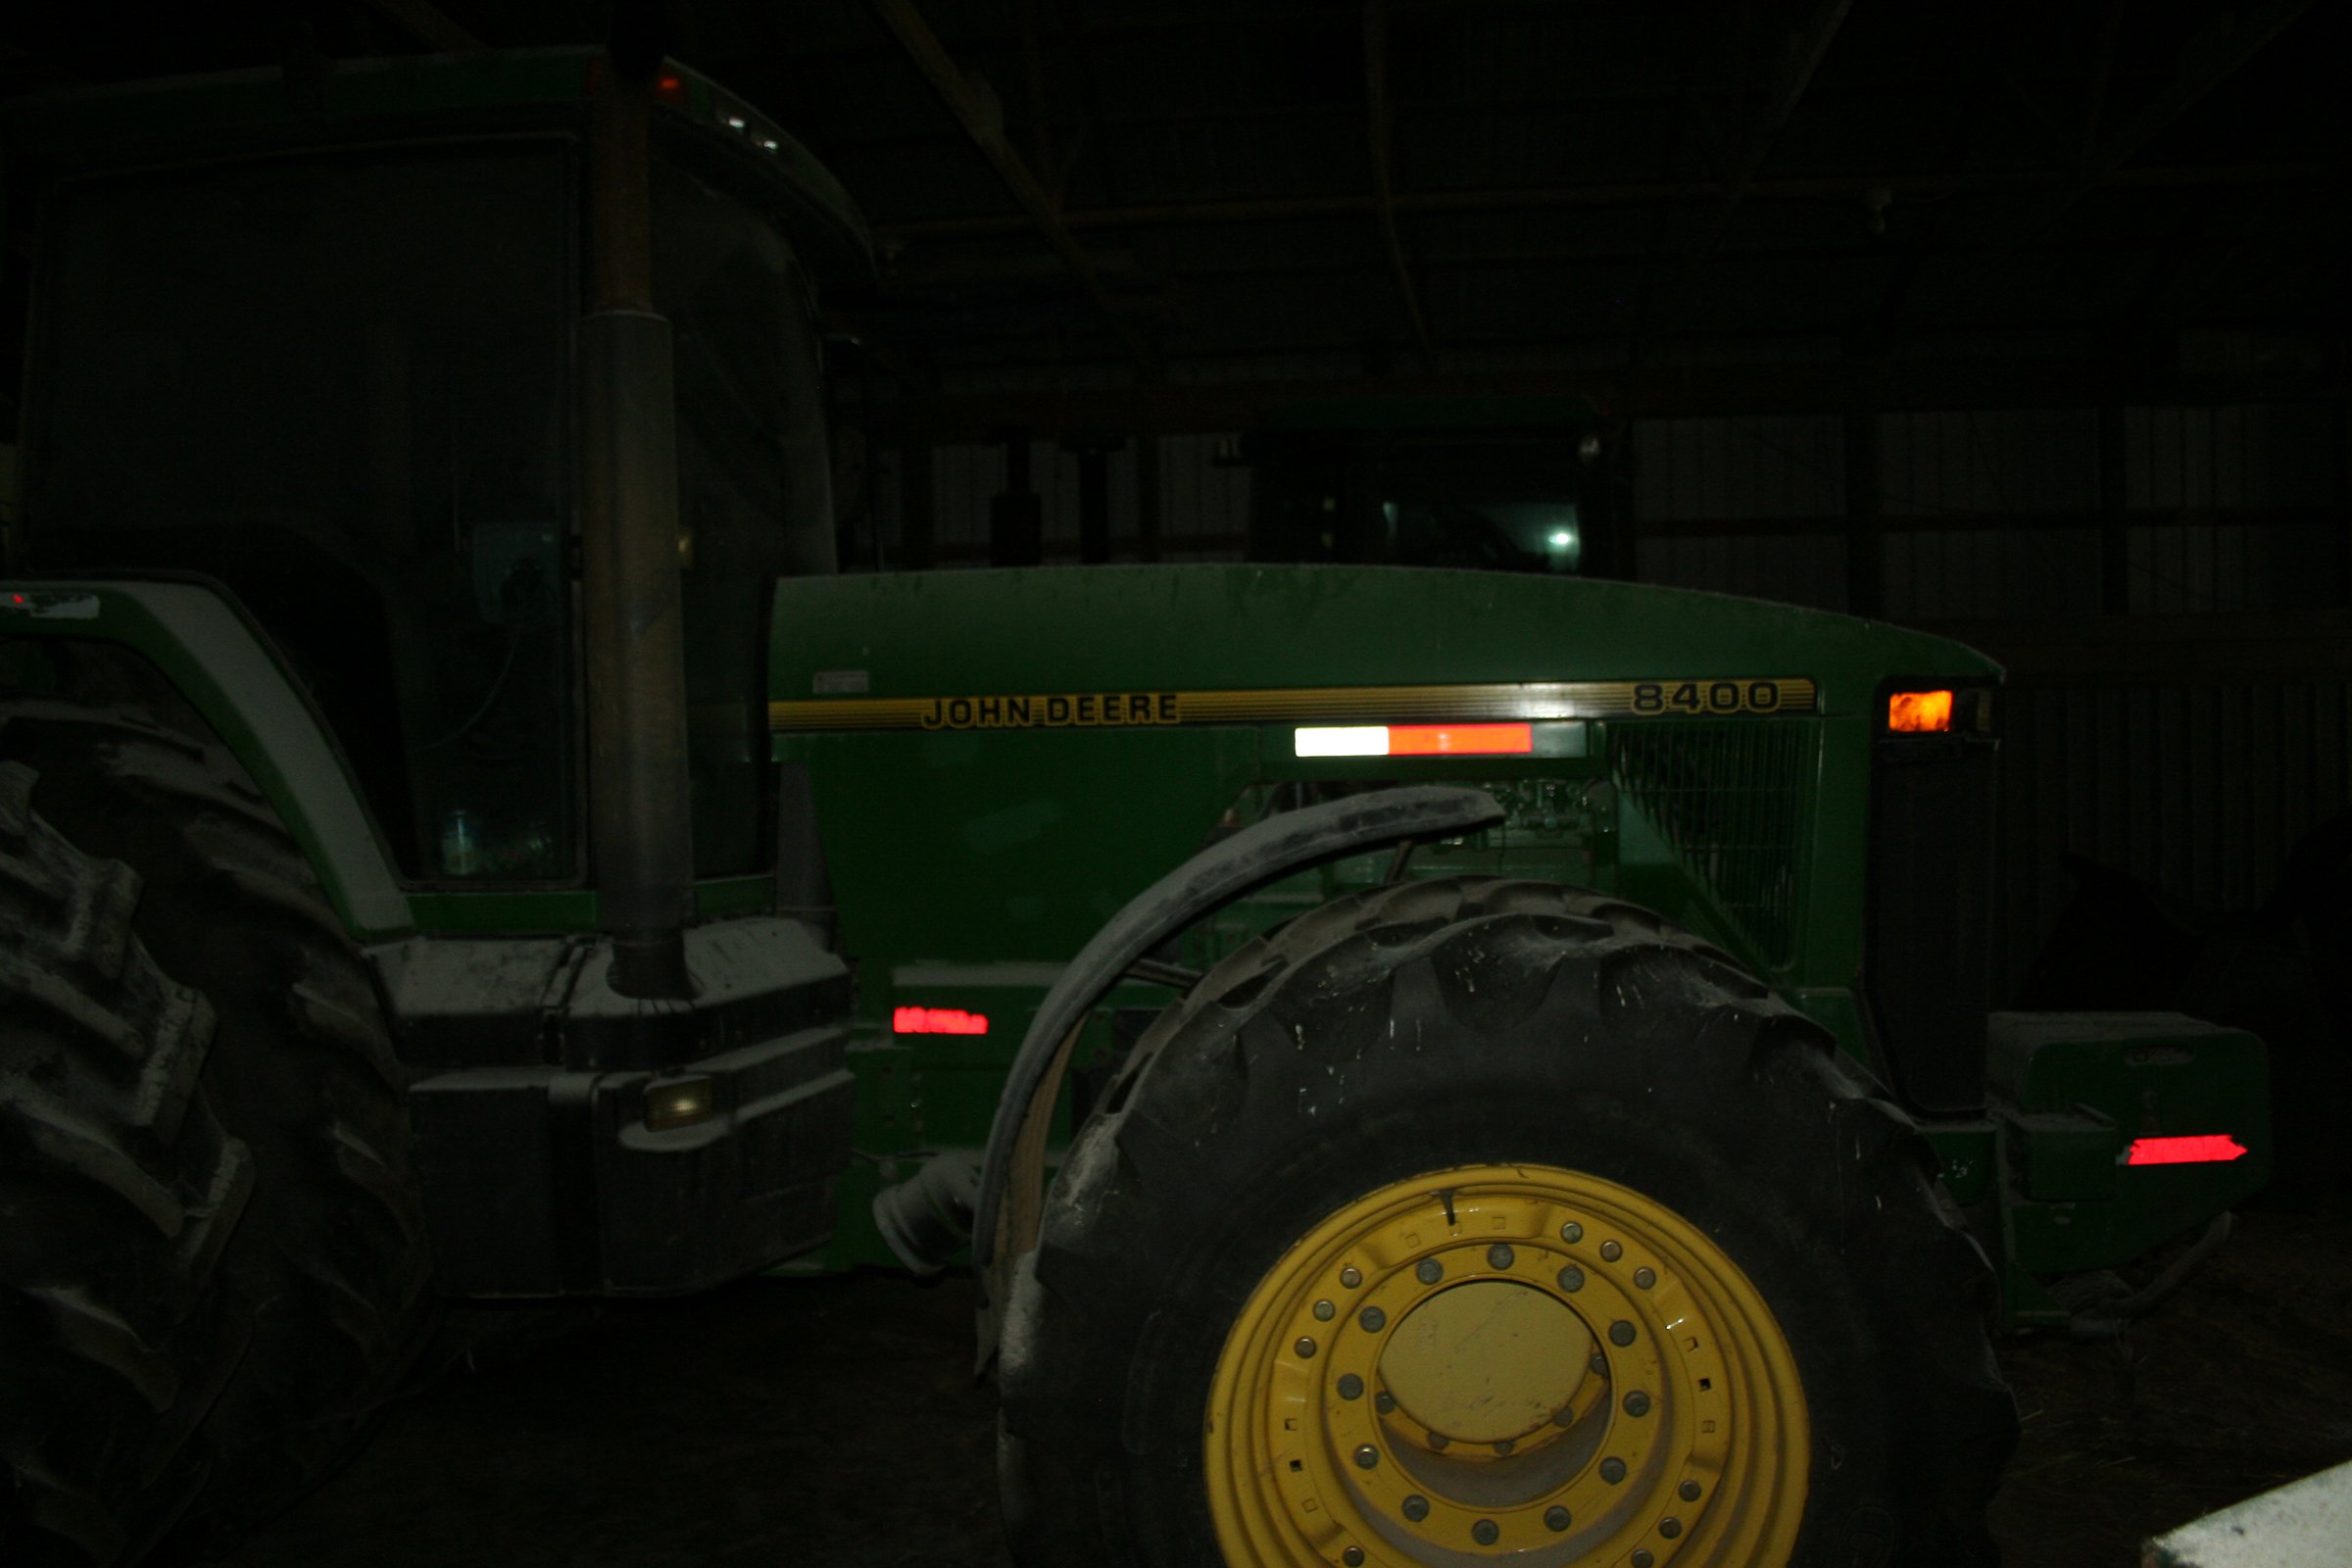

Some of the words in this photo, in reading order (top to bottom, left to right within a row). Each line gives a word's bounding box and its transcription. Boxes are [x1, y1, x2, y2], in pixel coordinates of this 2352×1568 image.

[923, 696, 1032, 726] JOHN
[1047, 694, 1179, 723] DEERE
[1634, 681, 1779, 711] 8400
